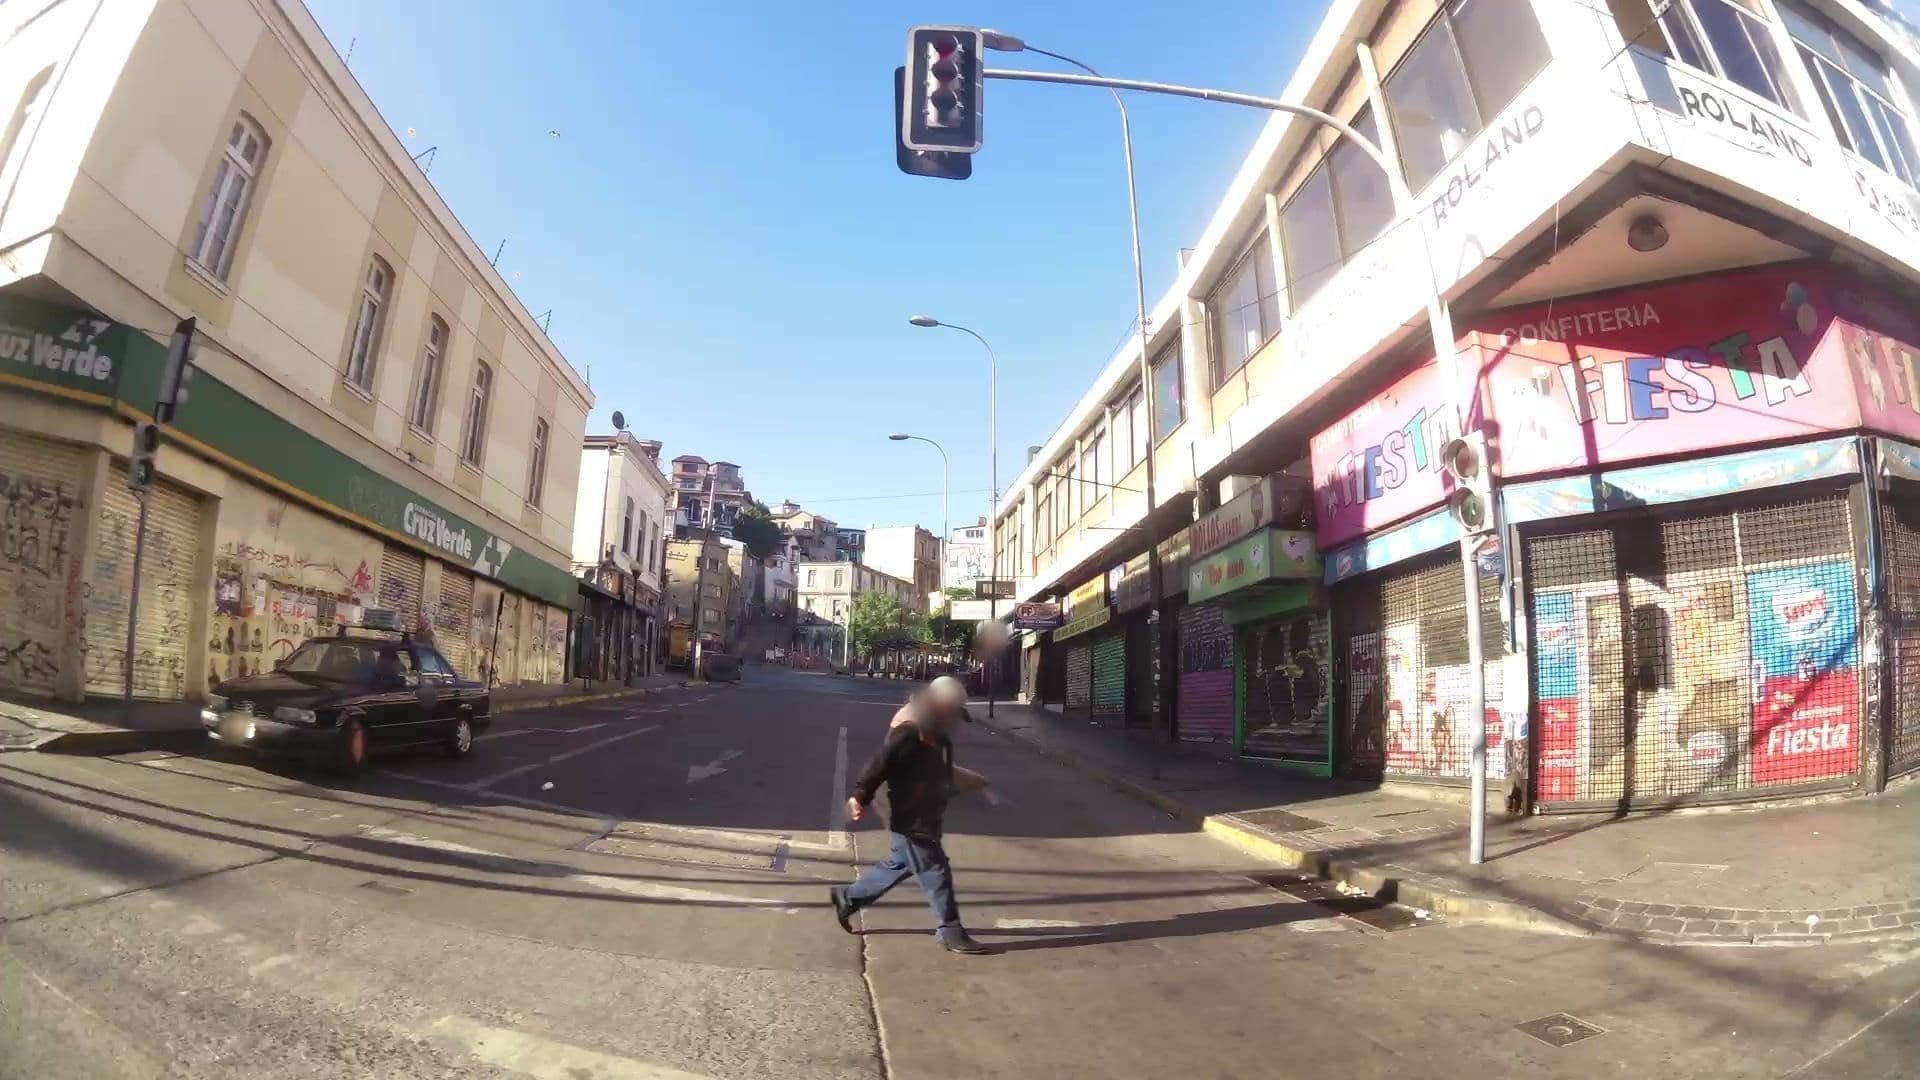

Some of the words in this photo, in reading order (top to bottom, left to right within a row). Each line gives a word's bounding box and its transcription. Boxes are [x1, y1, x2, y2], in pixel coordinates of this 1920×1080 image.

[1678, 86, 1813, 167] ROLAND
[1432, 105, 1545, 230] ROLAND
[1500, 303, 1661, 349] CONFITERIA
[1557, 331, 1812, 426] FIESTA
[1767, 720, 1850, 757] Fiesta
